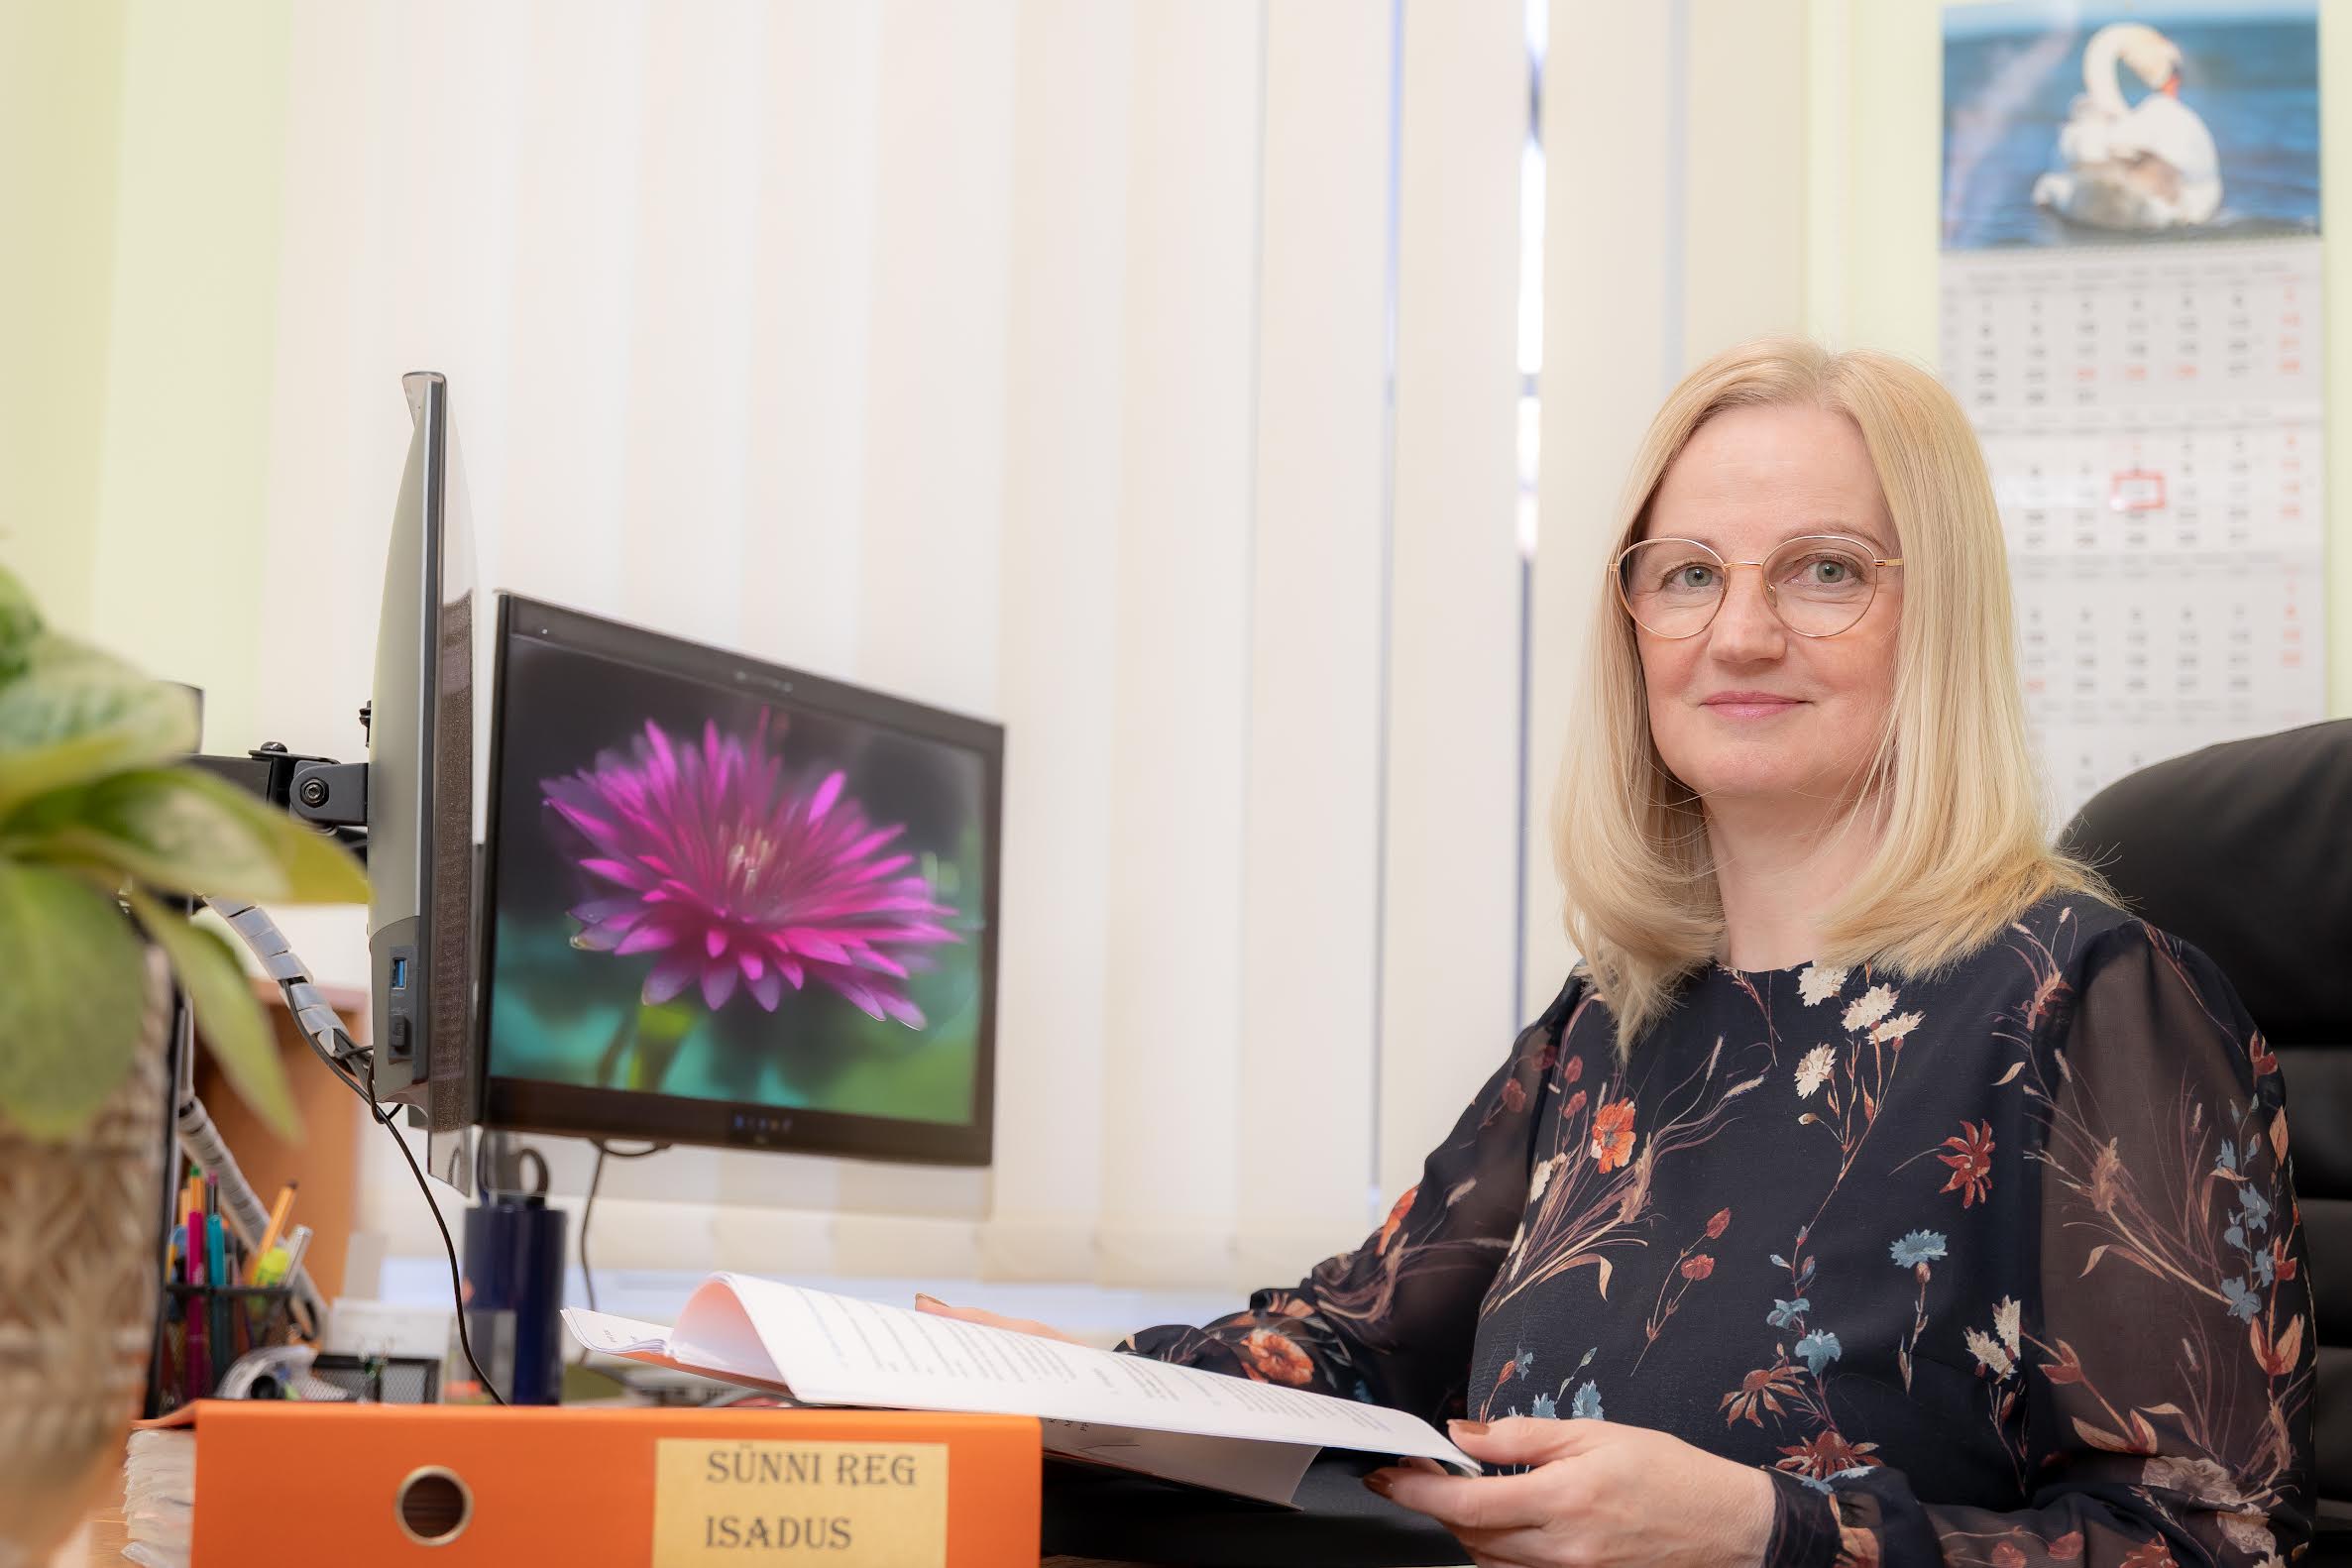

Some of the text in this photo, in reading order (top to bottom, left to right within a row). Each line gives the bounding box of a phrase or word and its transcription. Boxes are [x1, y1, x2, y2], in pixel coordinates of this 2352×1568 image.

[706, 1442, 917, 1487] SÜNNI REG
[705, 1514, 853, 1549] ISADUS
